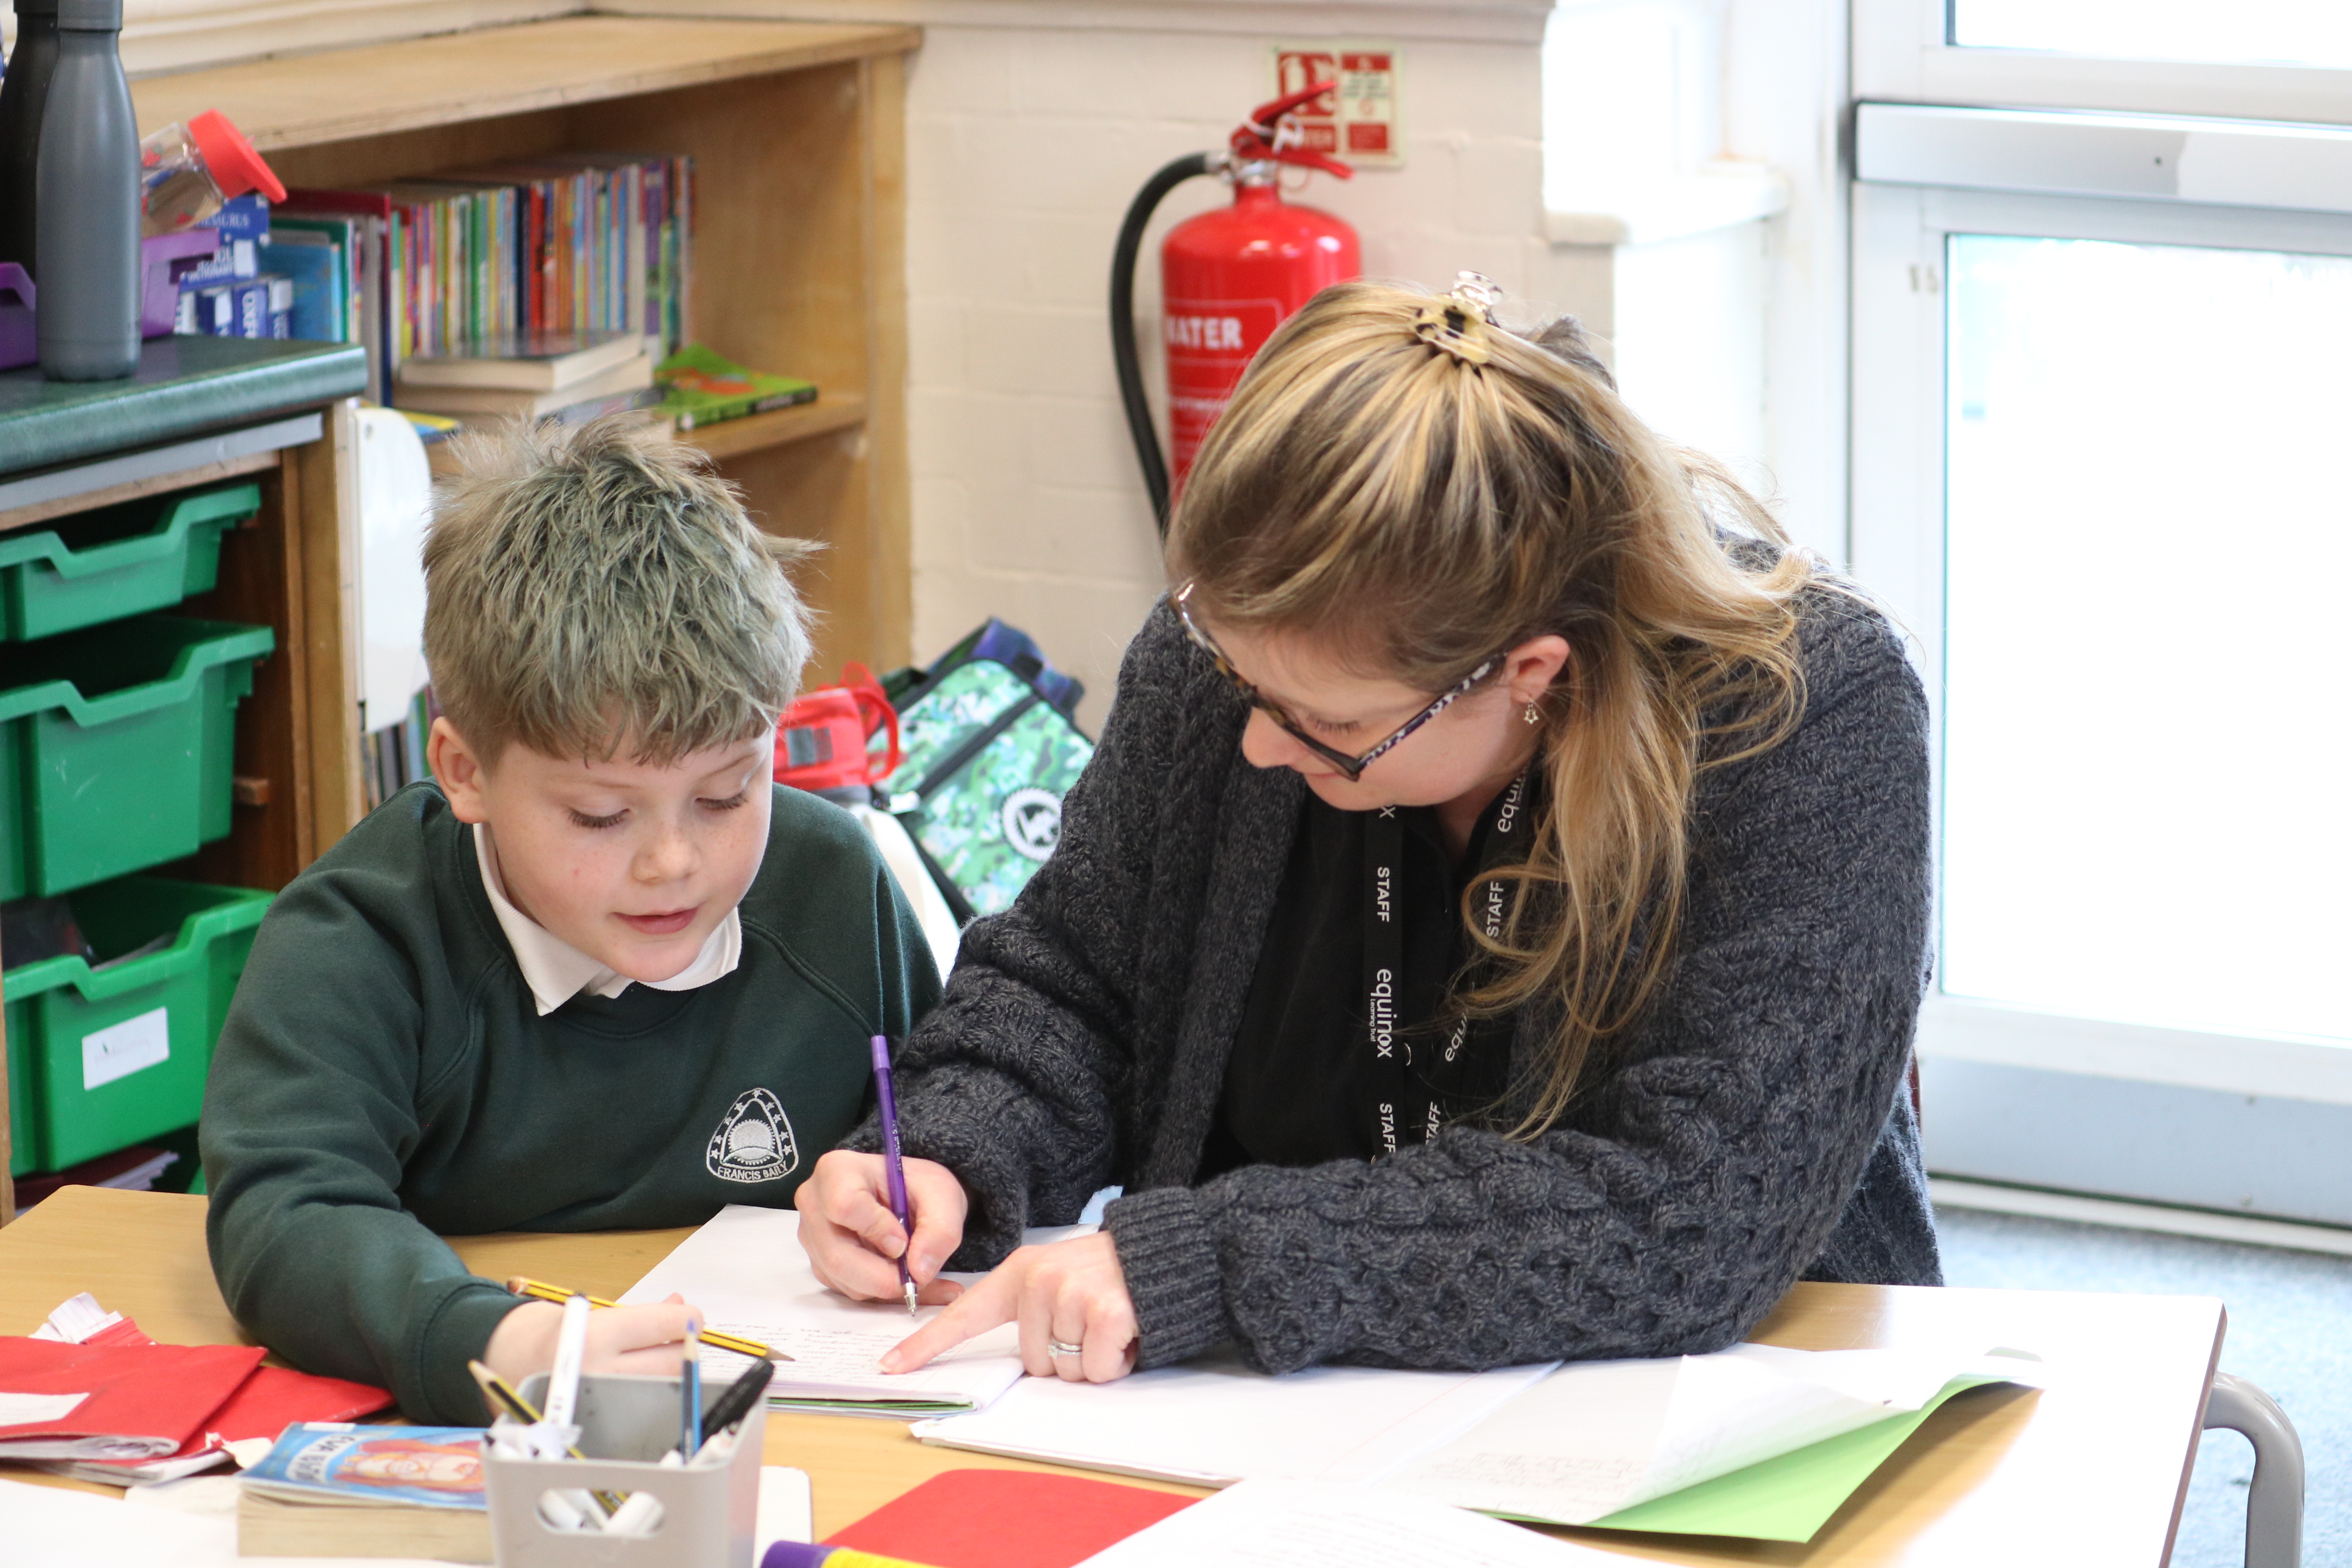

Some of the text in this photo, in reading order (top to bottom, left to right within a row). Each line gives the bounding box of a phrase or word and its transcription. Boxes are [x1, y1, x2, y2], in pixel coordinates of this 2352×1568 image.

[1377, 866, 1390, 922] STAFF
[1486, 881, 1504, 938] STAFF
[1370, 968, 1397, 1058] equinox
[1379, 1102, 1396, 1153] STAFF
[717, 1160, 788, 1180] FRANCIS BAILY
